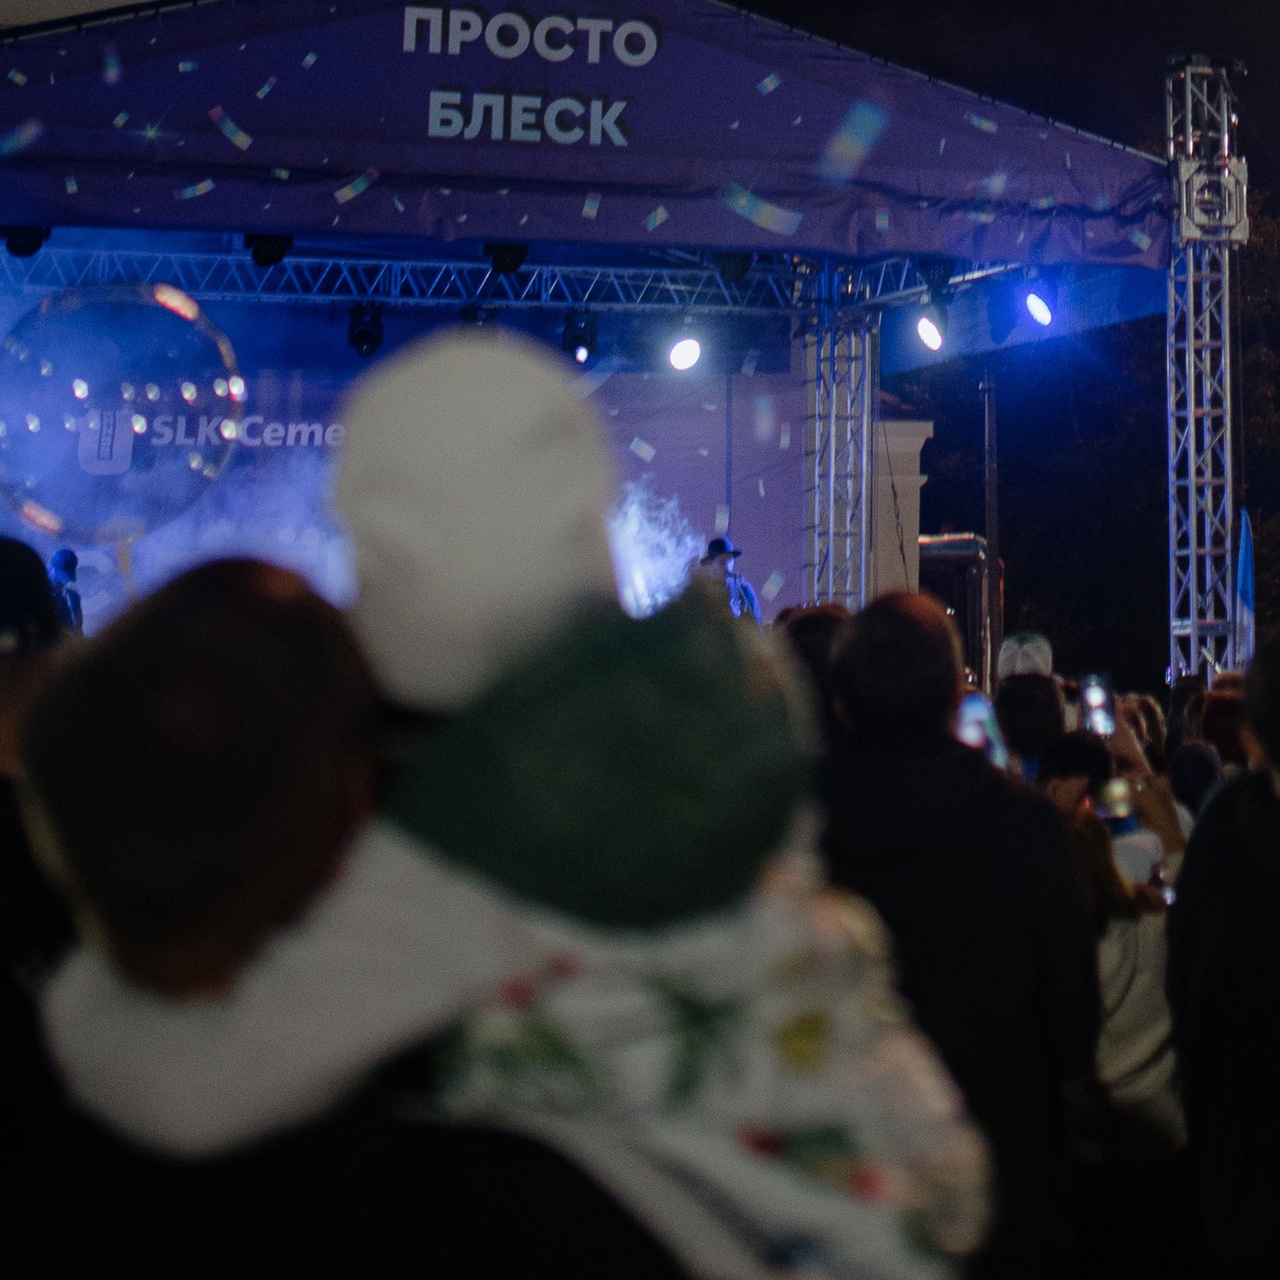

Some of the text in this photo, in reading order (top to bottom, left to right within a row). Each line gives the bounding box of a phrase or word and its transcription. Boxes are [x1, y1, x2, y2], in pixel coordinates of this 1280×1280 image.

[403, 6, 658, 67] ПРОСТО
[428, 90, 628, 147] БЛЕСК
[151, 414, 223, 446] SLK
